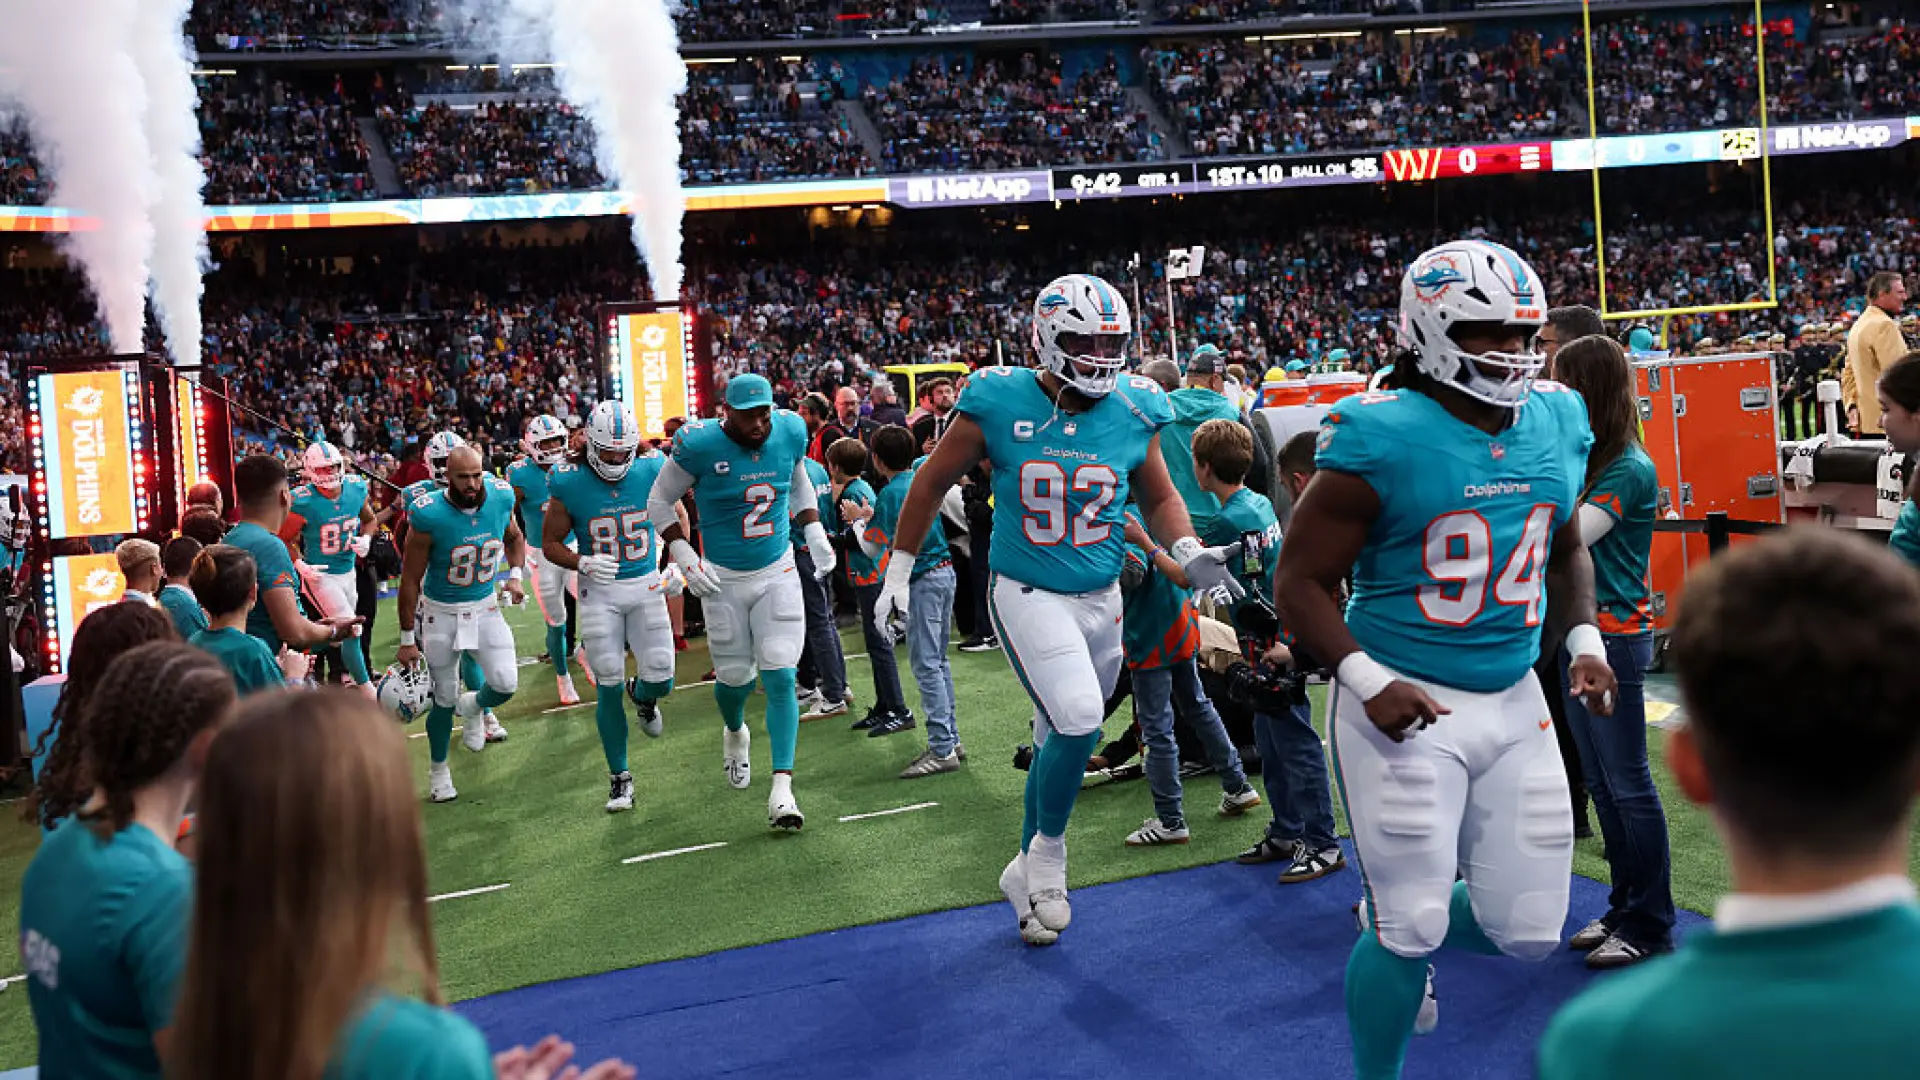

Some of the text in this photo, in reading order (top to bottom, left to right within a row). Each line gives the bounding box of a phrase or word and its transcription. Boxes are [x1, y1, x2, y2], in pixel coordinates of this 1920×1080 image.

[1802, 125, 1890, 148] NetApp
[1291, 165, 1324, 178] BALL
[1327, 162, 1347, 176] ON
[1351, 157, 1378, 179] 35
[1458, 148, 1477, 173] 0
[936, 176, 1031, 202] NetApp
[1071, 171, 1181, 195] 9:42 QTR 1
[1013, 420, 1034, 440] C
[72, 419, 101, 524] DOLPHINS
[714, 461, 730, 474] C
[1463, 480, 1531, 499] Dolphins
[742, 482, 777, 539] 2
[1020, 460, 1119, 547] 92
[588, 509, 651, 563] 85
[447, 538, 506, 588] 89
[1416, 503, 1557, 628] 94
